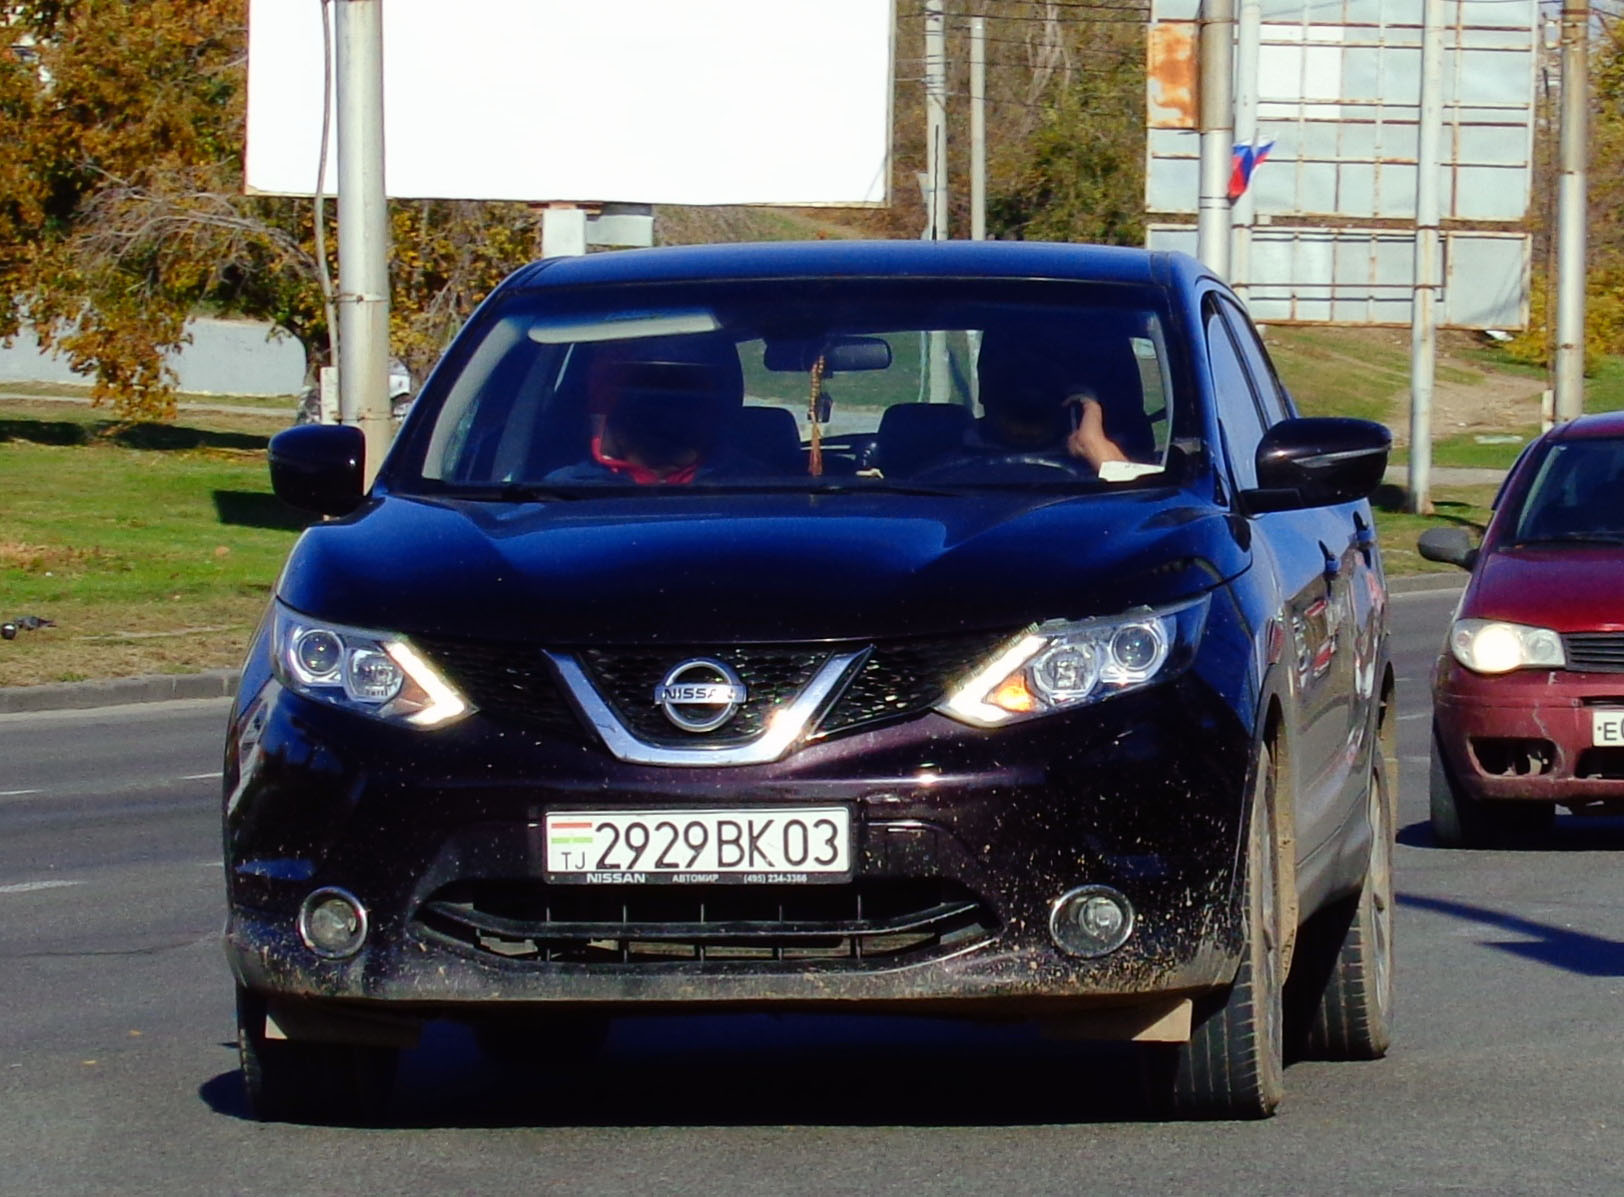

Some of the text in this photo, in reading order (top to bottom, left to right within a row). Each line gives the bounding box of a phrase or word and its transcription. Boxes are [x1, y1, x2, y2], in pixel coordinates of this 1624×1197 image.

[595, 818, 839, 870] 2929 BK 03
[561, 851, 586, 870] TJ
[587, 873, 646, 883] NISSAN
